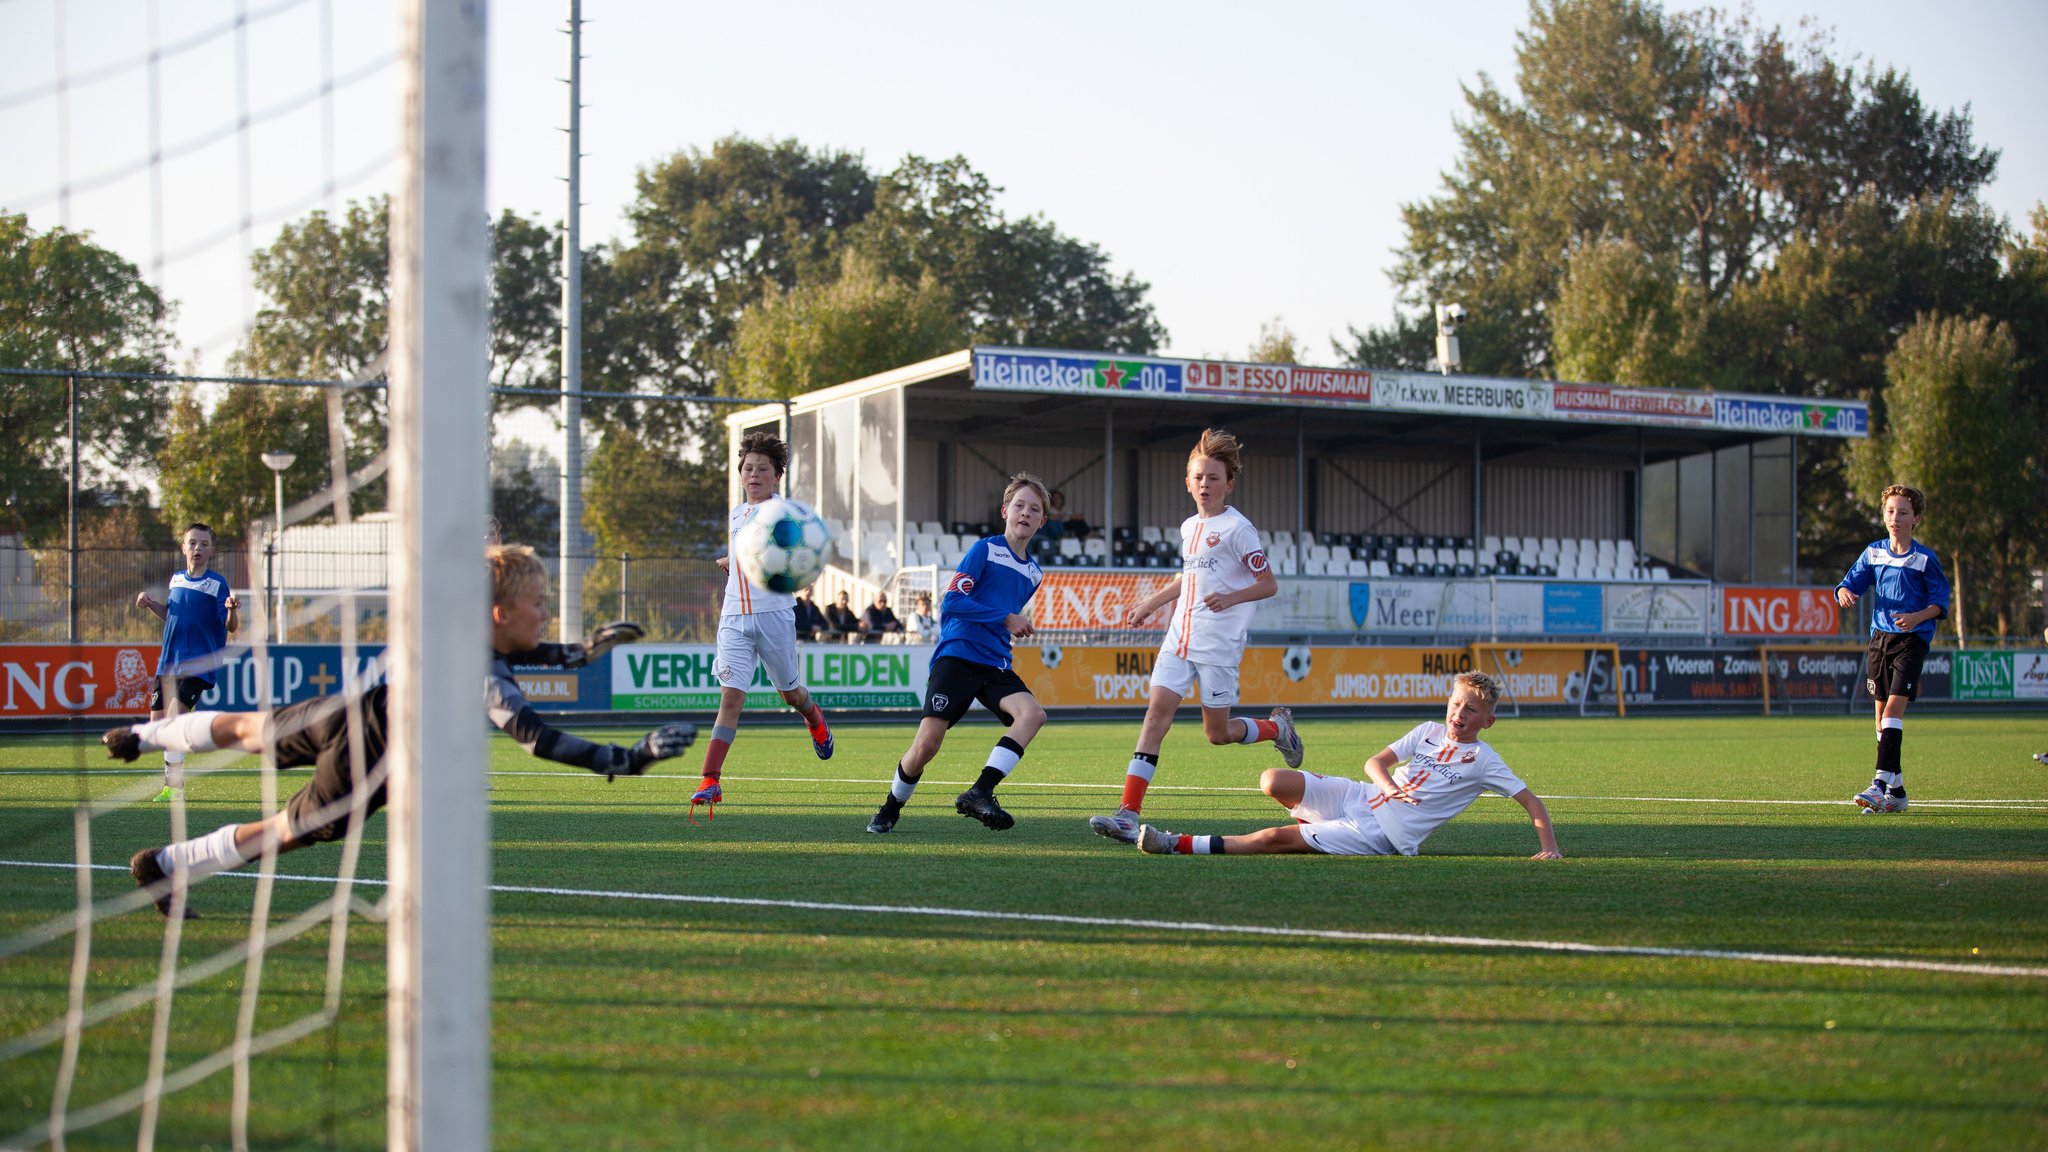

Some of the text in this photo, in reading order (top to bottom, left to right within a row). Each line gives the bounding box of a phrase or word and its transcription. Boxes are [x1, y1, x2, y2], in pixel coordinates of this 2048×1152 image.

[976, 355, 1098, 389] Heineken
[1243, 368, 1370, 395] ESSO HUISMAN
[1445, 386, 1524, 409] MEERBURG
[1555, 390, 1609, 408] HUISMAN
[1717, 401, 1804, 428] Heineken
[1375, 585, 1412, 597] van der
[1042, 585, 1124, 625] ING
[1376, 599, 1435, 626] Meer
[1729, 597, 1790, 632] ING
[806, 654, 910, 687] LEIDEN
[1423, 654, 1471, 675] HALLO
[1666, 655, 1714, 675] Vloeren
[1799, 656, 1857, 678] Gordijnen
[1331, 674, 1379, 699] JUMBO
